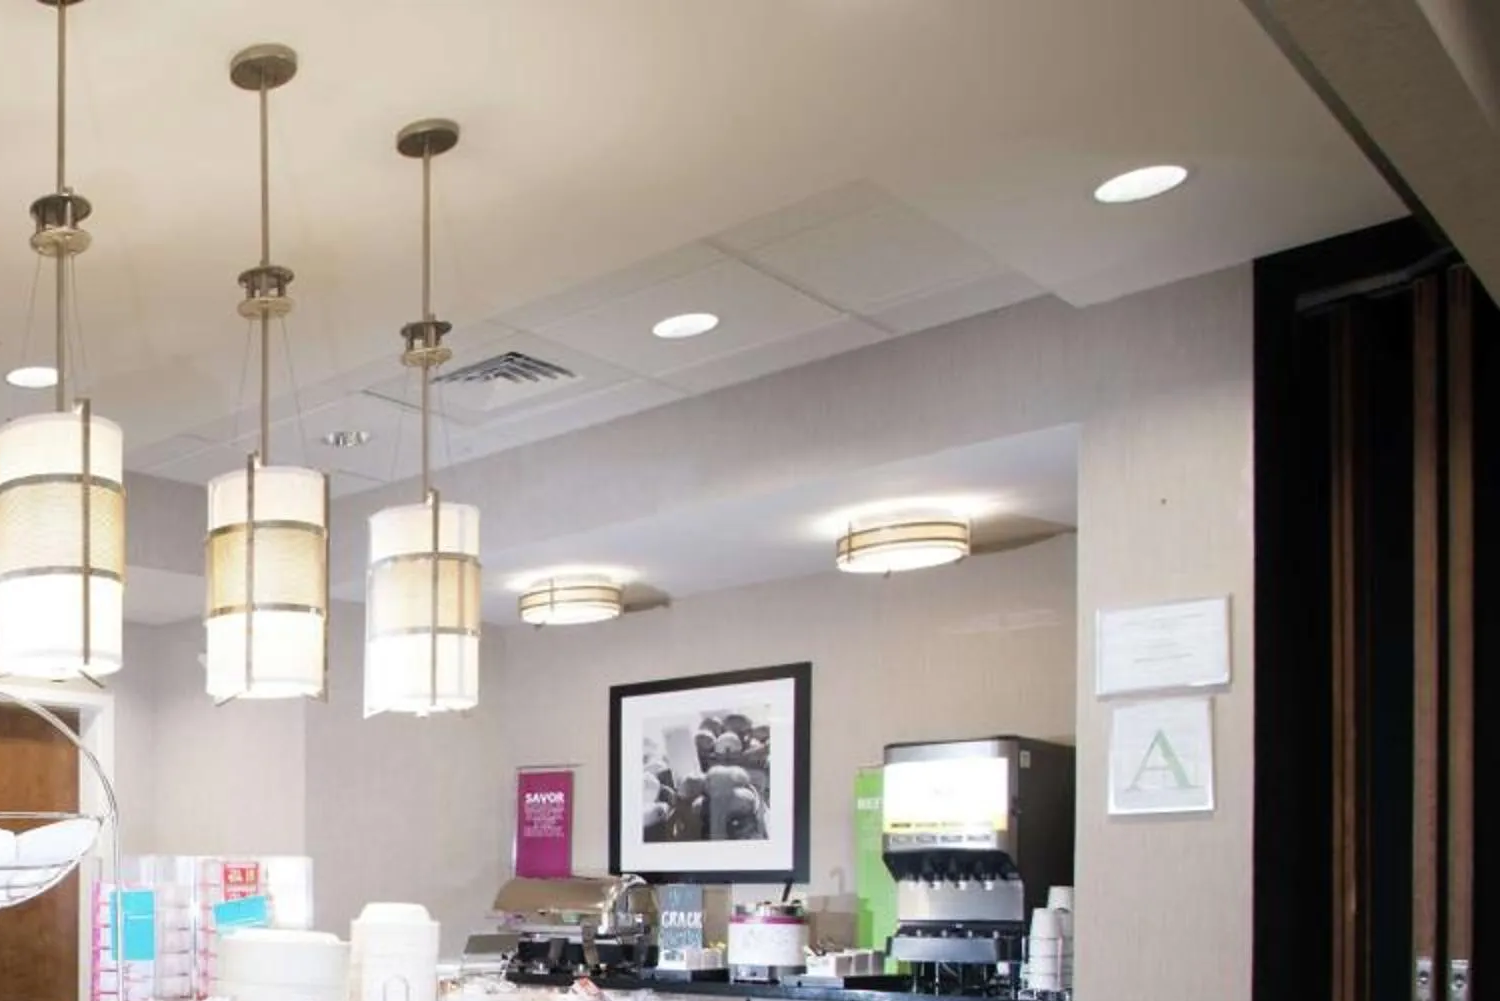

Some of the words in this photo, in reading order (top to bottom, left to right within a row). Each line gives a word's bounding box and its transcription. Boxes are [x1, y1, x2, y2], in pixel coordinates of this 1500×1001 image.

[1124, 728, 1205, 793] A
[525, 792, 565, 804] SAVOR
[661, 911, 703, 929] CRACK
